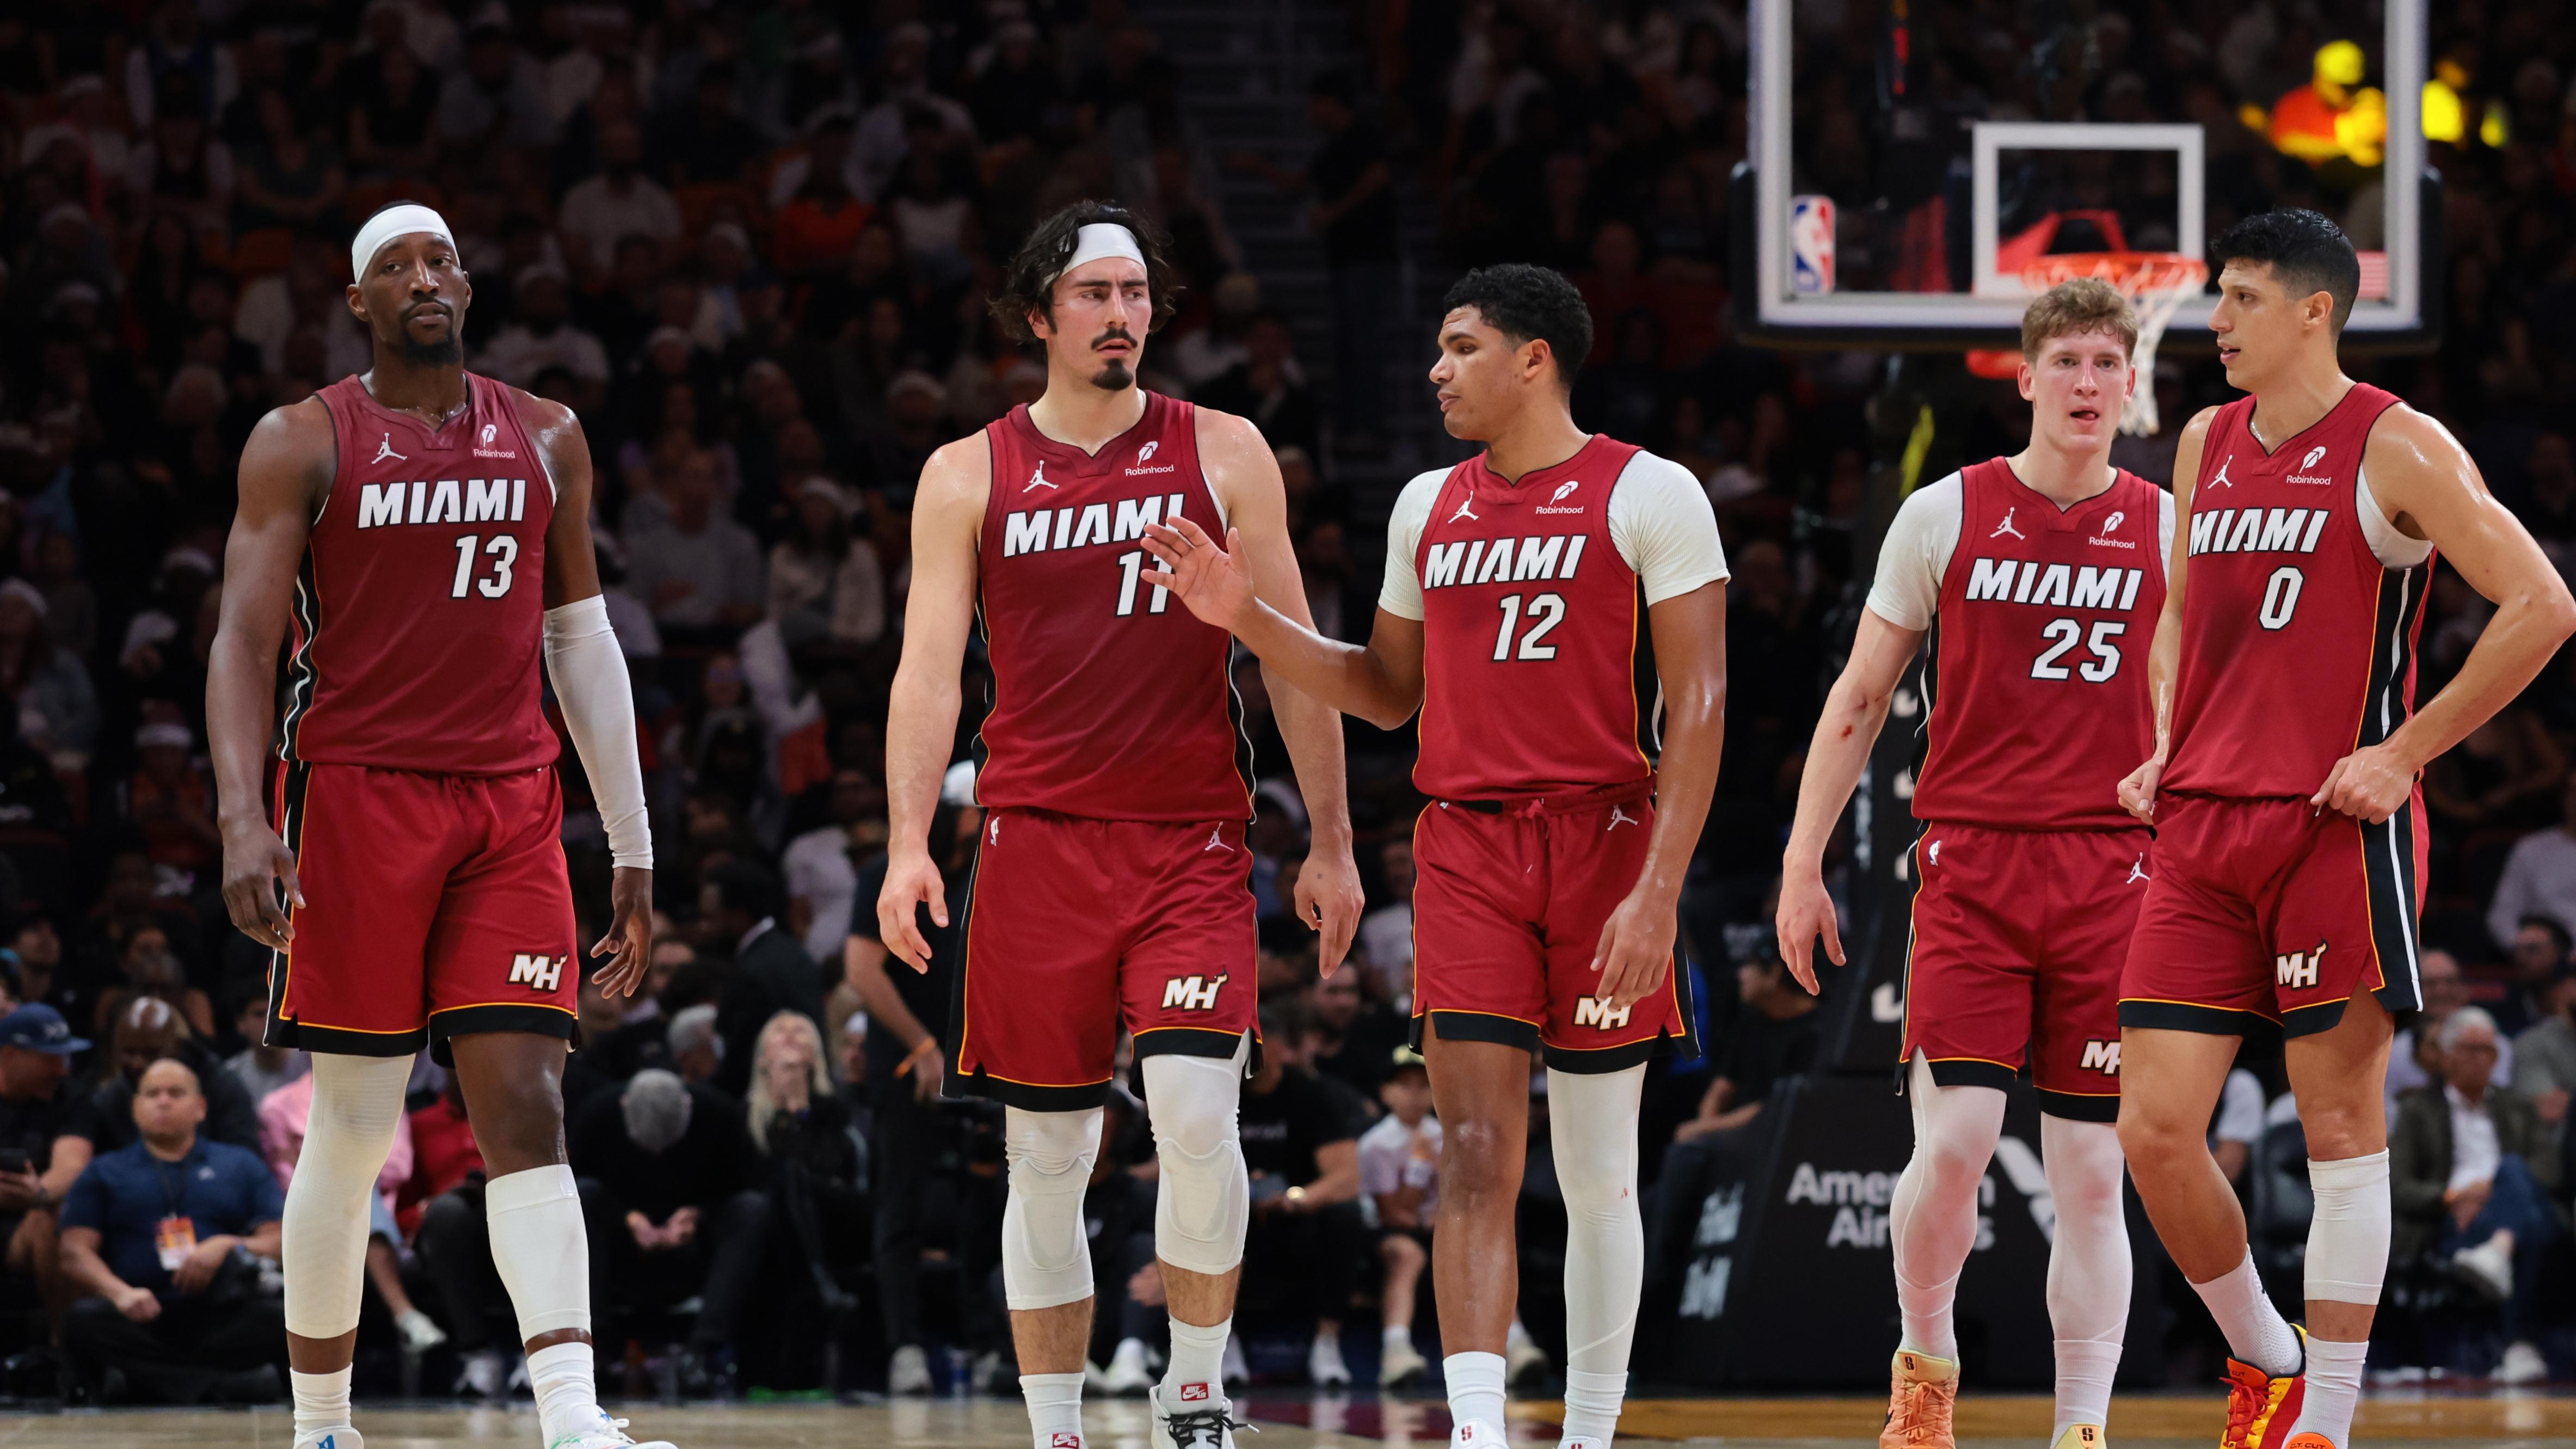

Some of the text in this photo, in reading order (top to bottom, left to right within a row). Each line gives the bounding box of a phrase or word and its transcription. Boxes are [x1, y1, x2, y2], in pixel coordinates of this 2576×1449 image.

[473, 448, 515, 459] Robinhood
[1125, 464, 1174, 476] Robinhood
[357, 478, 527, 529] MIAMI
[2286, 475, 2331, 486] Robinhood
[1003, 493, 1184, 558] MIAMI
[1536, 506, 1584, 514] Robinhood
[2188, 507, 2330, 558] MIAMI
[451, 534, 519, 599] 13
[1424, 535, 1588, 590] MIAMI
[2089, 537, 2135, 549] Robinhood
[1115, 550, 1173, 617] 11
[1965, 557, 2144, 611] MIAMI
[2258, 565, 2305, 631] 0
[1492, 592, 1567, 662] 12
[2029, 617, 2127, 683] 25
[1185, 1386, 1201, 1394] NIKE
